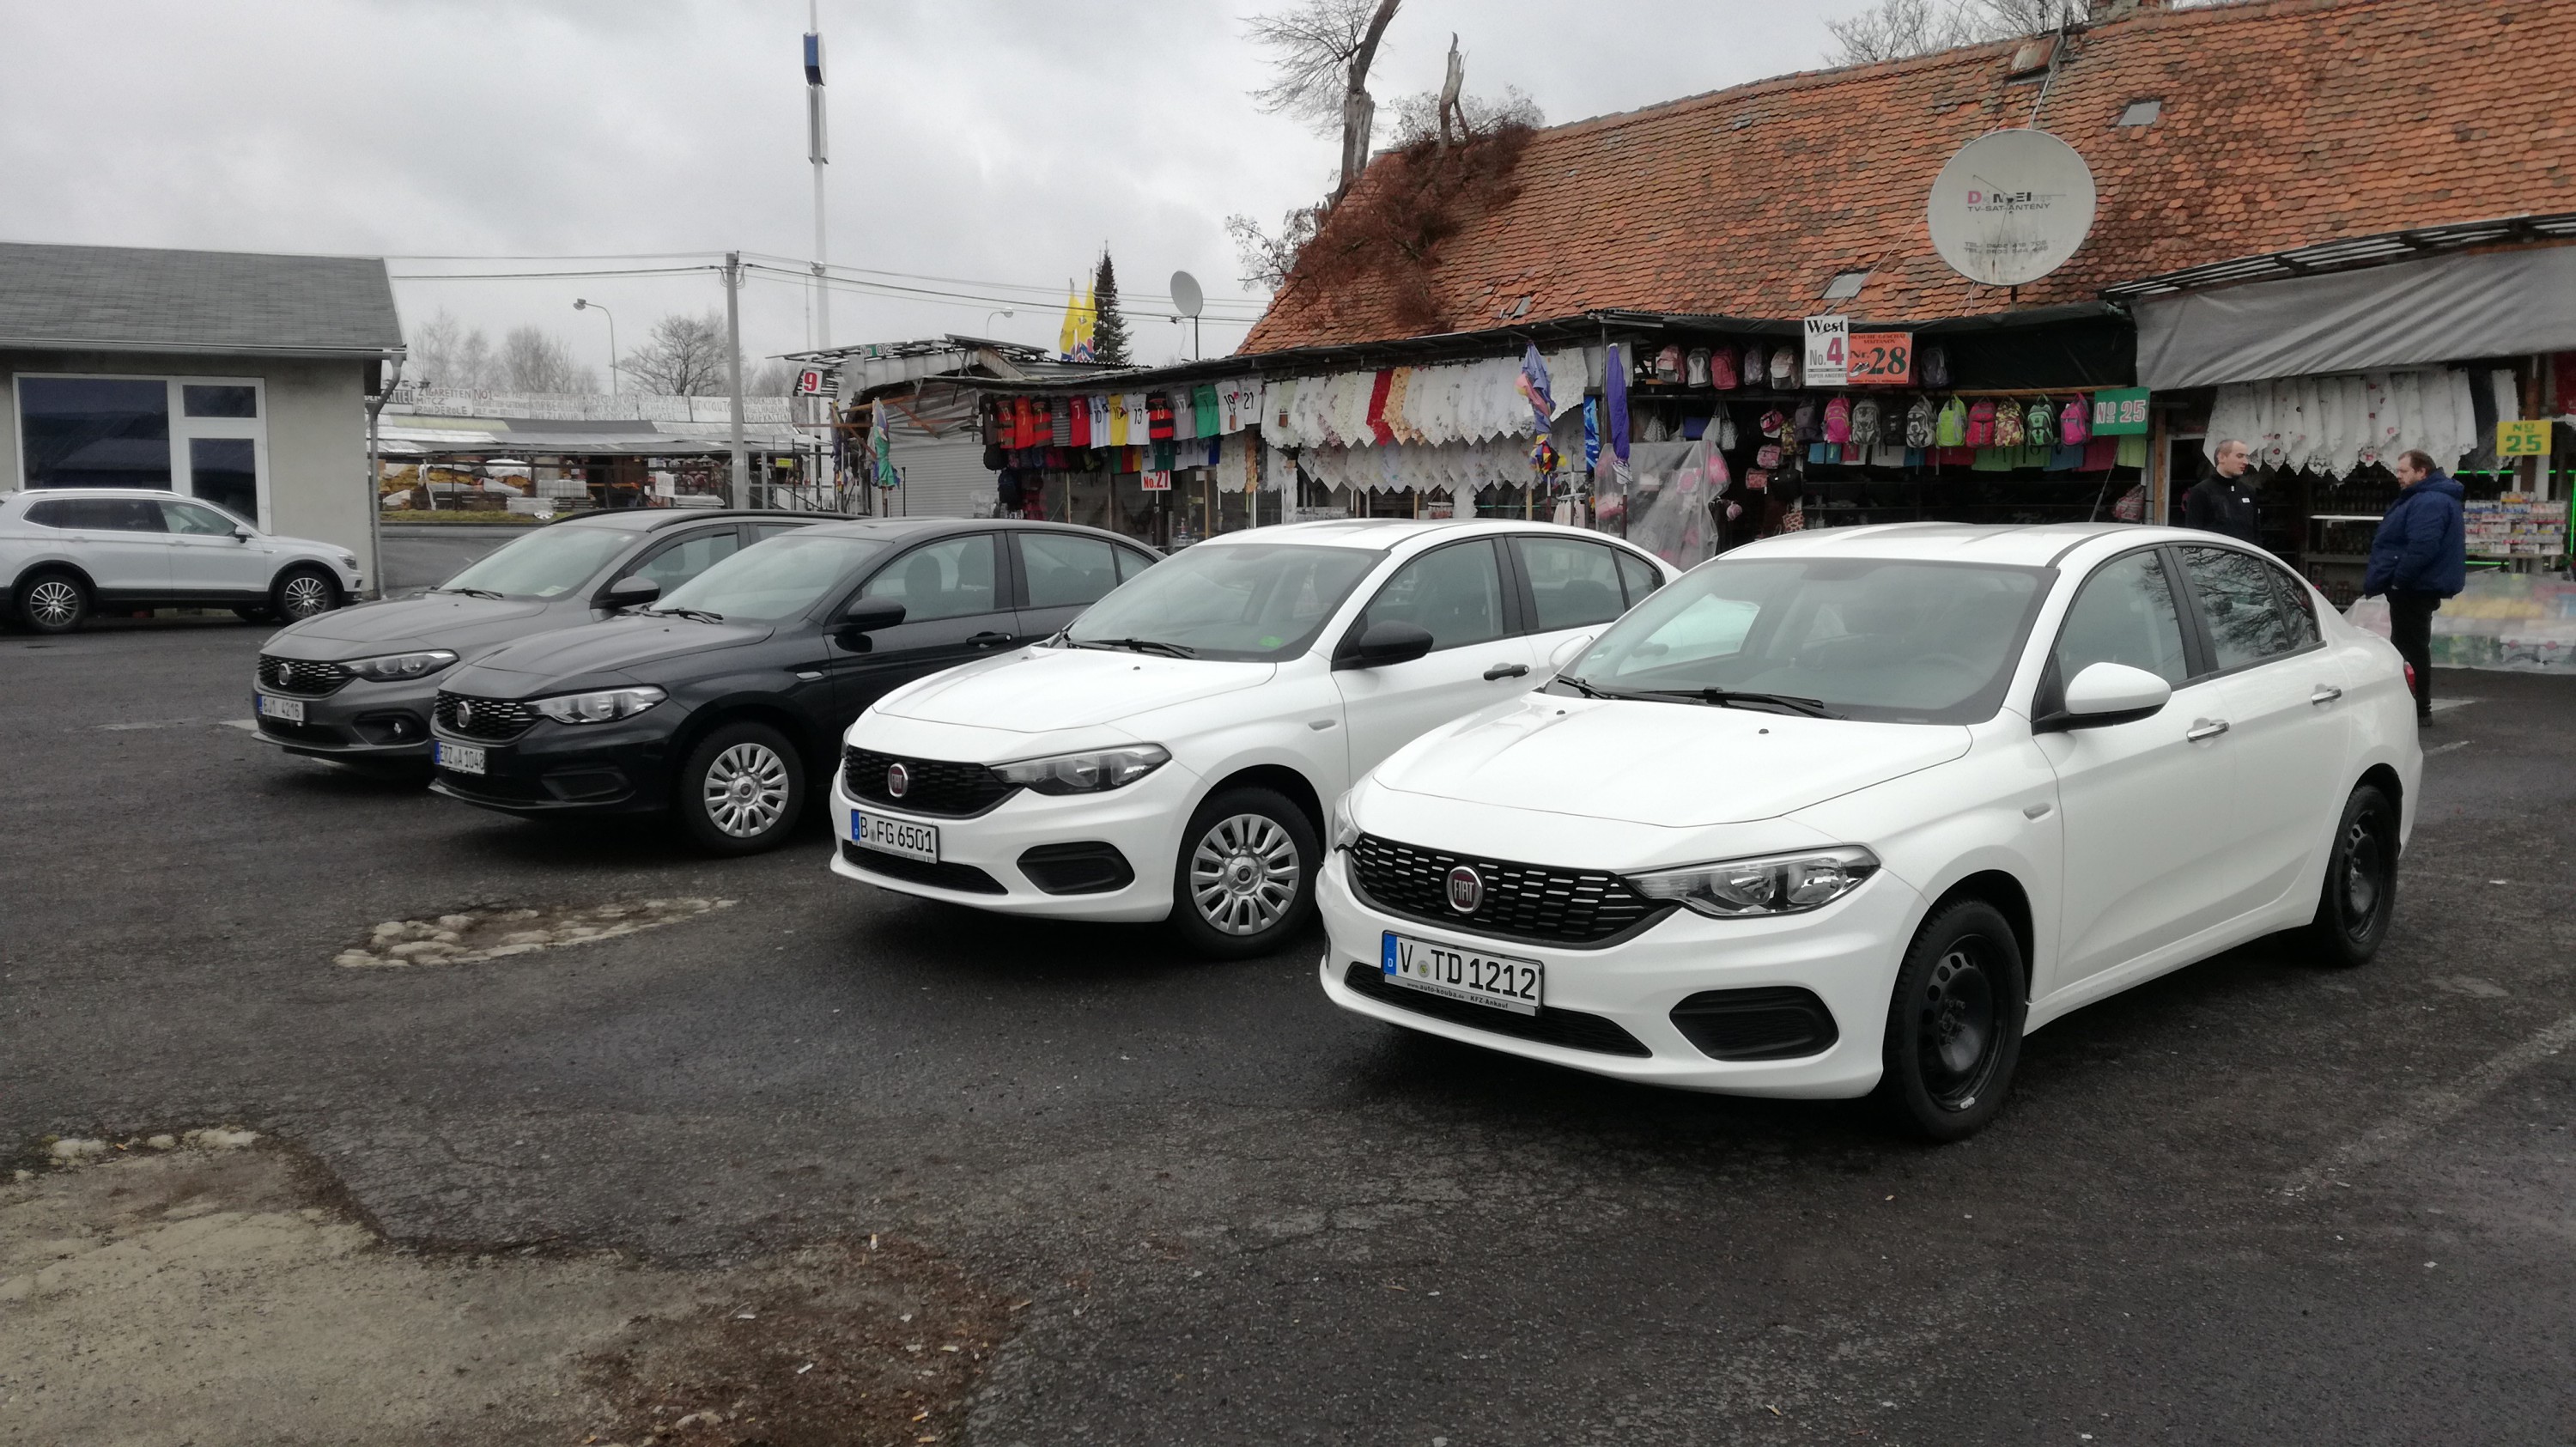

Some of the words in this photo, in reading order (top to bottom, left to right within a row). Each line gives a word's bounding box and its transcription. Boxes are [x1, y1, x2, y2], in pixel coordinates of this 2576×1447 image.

[1967, 203, 2050, 212] TV-SAT-ANTENY
[1807, 319, 1845, 333] West
[876, 344, 893, 356] 02
[1827, 337, 1844, 365] 4
[1867, 347, 1907, 374] 28
[804, 372, 817, 392] 9
[1243, 392, 1255, 410] 21
[1074, 404, 1081, 420] 7
[1094, 410, 1103, 425] 10
[1134, 408, 1143, 425] 13
[2119, 399, 2147, 423] 25
[2506, 434, 2542, 453] 25
[860, 817, 868, 838] B
[877, 821, 894, 845] FG
[898, 825, 933, 854] 6501
[1454, 879, 1474, 903] FIAT
[1400, 942, 1413, 973] V
[1431, 949, 1462, 984] TD
[1469, 958, 1535, 1000] 1212
